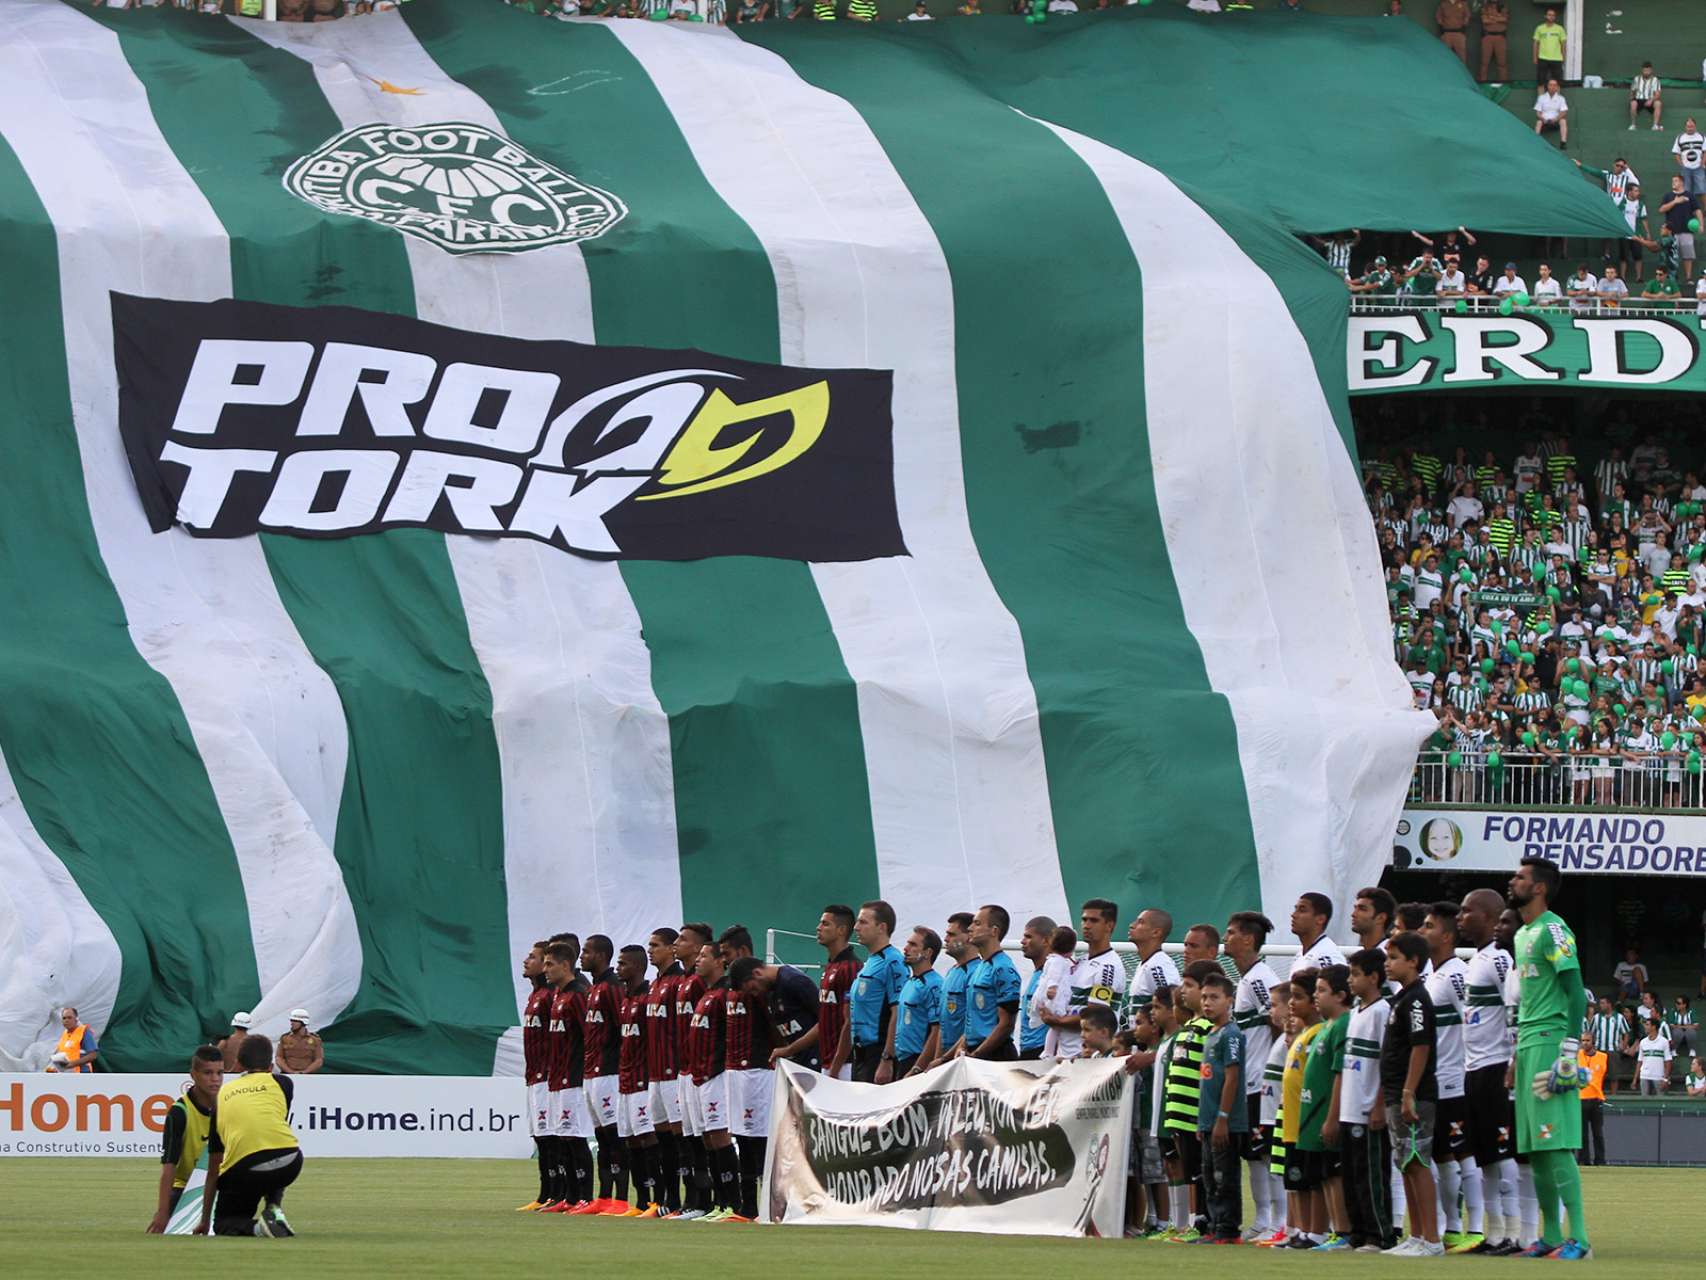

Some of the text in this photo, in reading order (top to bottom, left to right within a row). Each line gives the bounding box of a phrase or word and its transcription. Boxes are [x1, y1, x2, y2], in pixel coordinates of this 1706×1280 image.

[360, 130, 490, 158] FOOT
[492, 145, 586, 206] BALL
[1347, 315, 1706, 391] ERD
[171, 339, 562, 454] PRO
[158, 439, 653, 554] TORK
[1483, 816, 1666, 845] FORMANDO
[1095, 987, 1111, 1002] C
[16, 1140, 101, 1153] Construtivo
